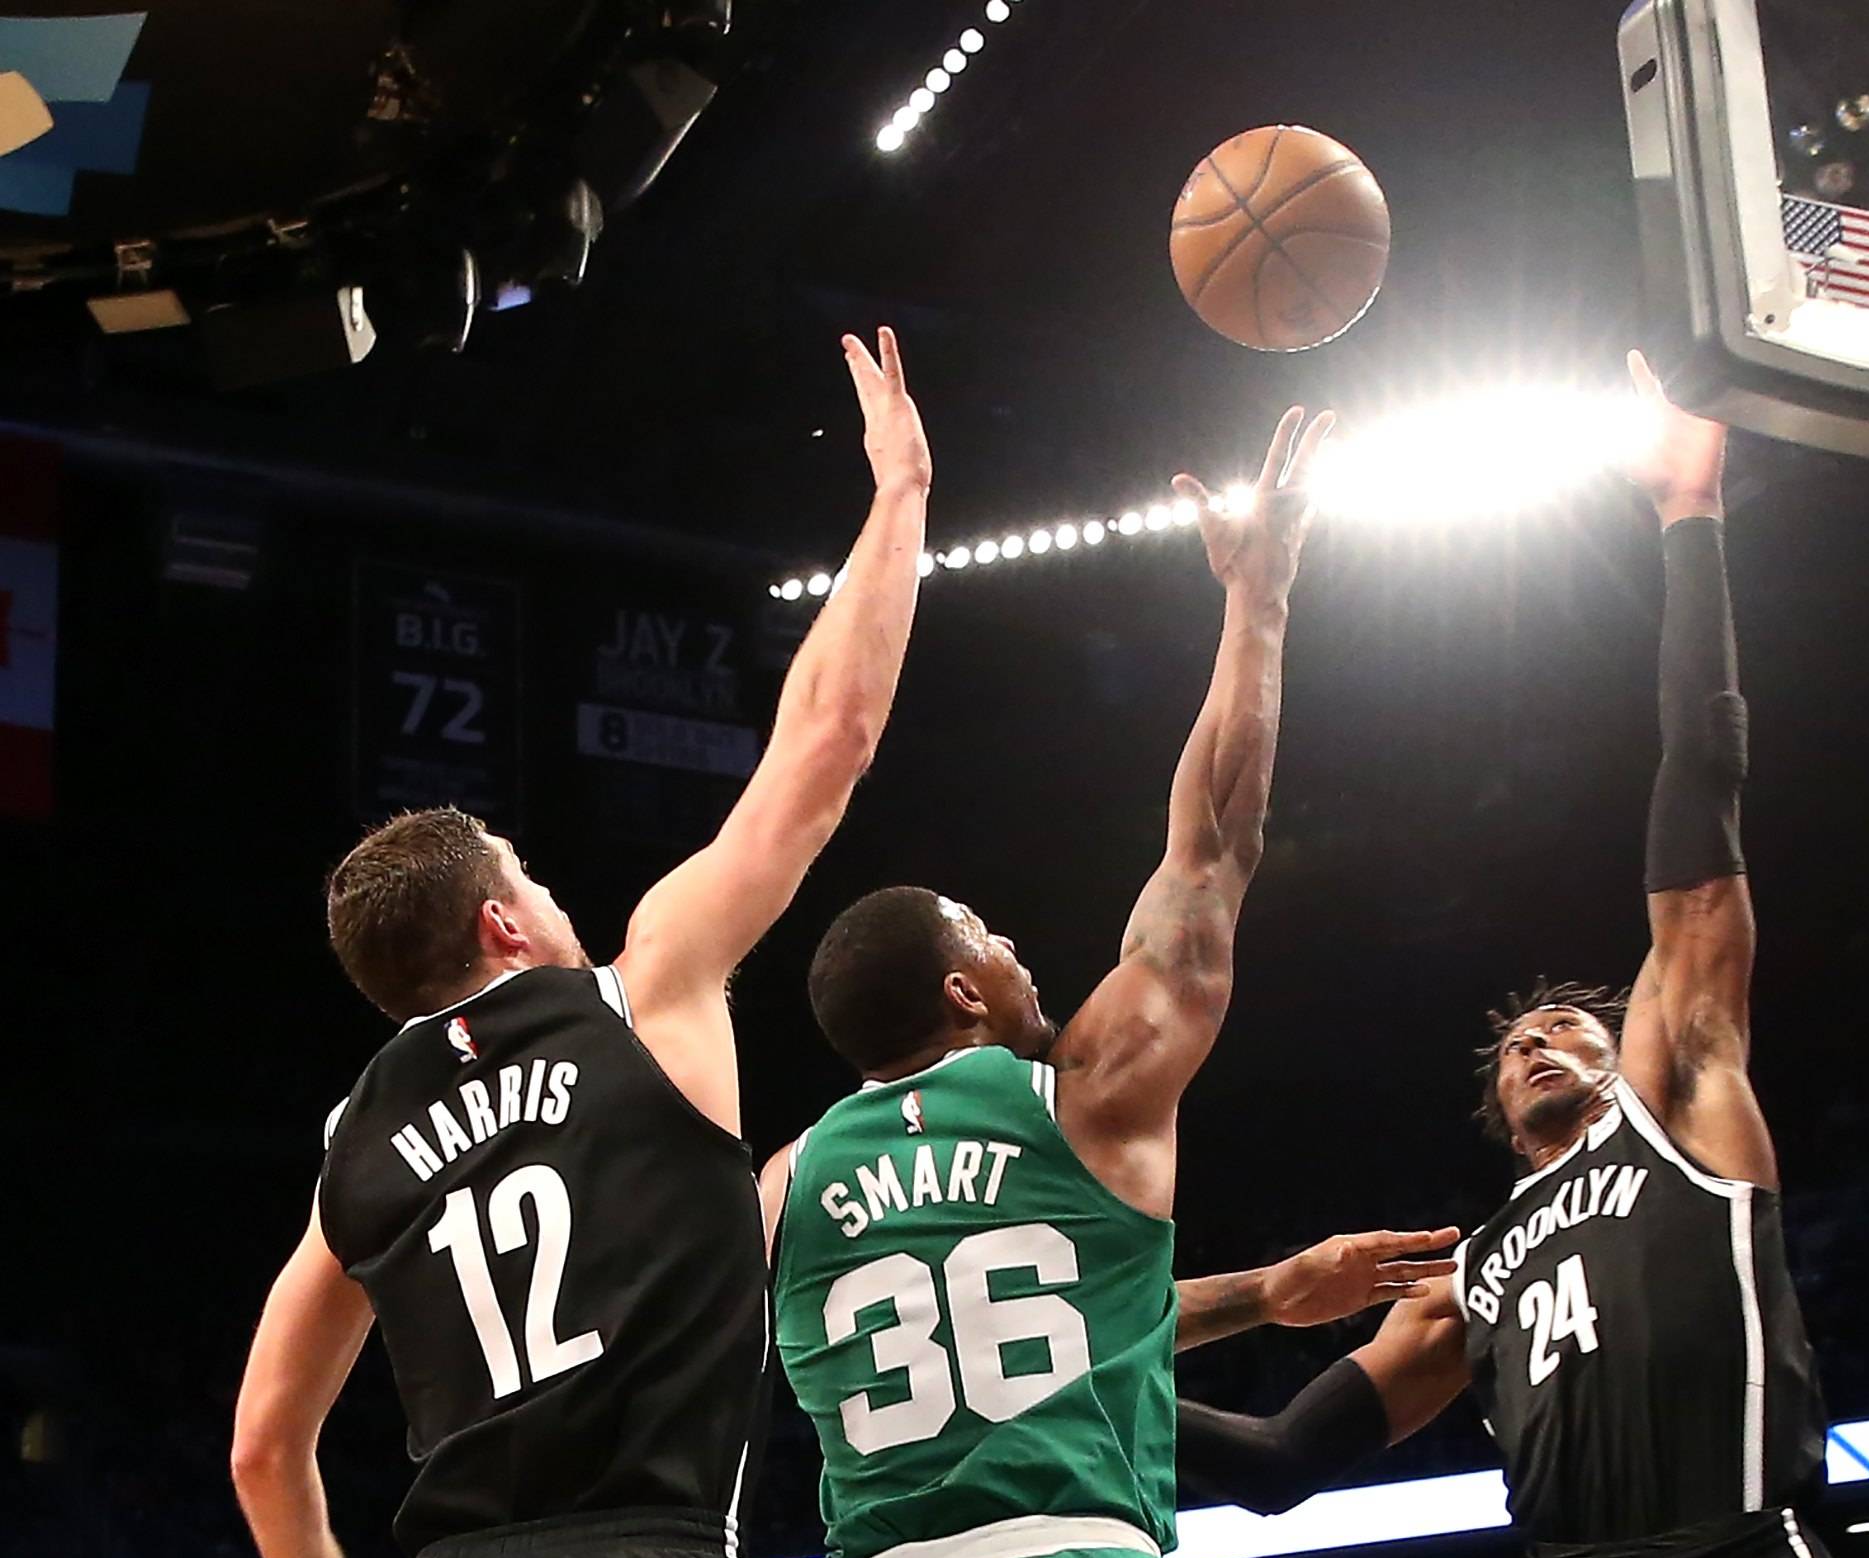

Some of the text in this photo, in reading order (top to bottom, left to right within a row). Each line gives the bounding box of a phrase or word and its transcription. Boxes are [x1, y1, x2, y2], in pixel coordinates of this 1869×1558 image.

[597, 609, 738, 676] JAY Z
[390, 670, 487, 745] 72
[600, 712, 628, 753] 8
[391, 1059, 580, 1182] HARRIS
[821, 1141, 1022, 1239] SMART
[1466, 1164, 1648, 1326] BROOKLYN
[429, 1164, 604, 1400] 12
[823, 1222, 1091, 1456] 36
[1517, 1253, 1600, 1388] 24
